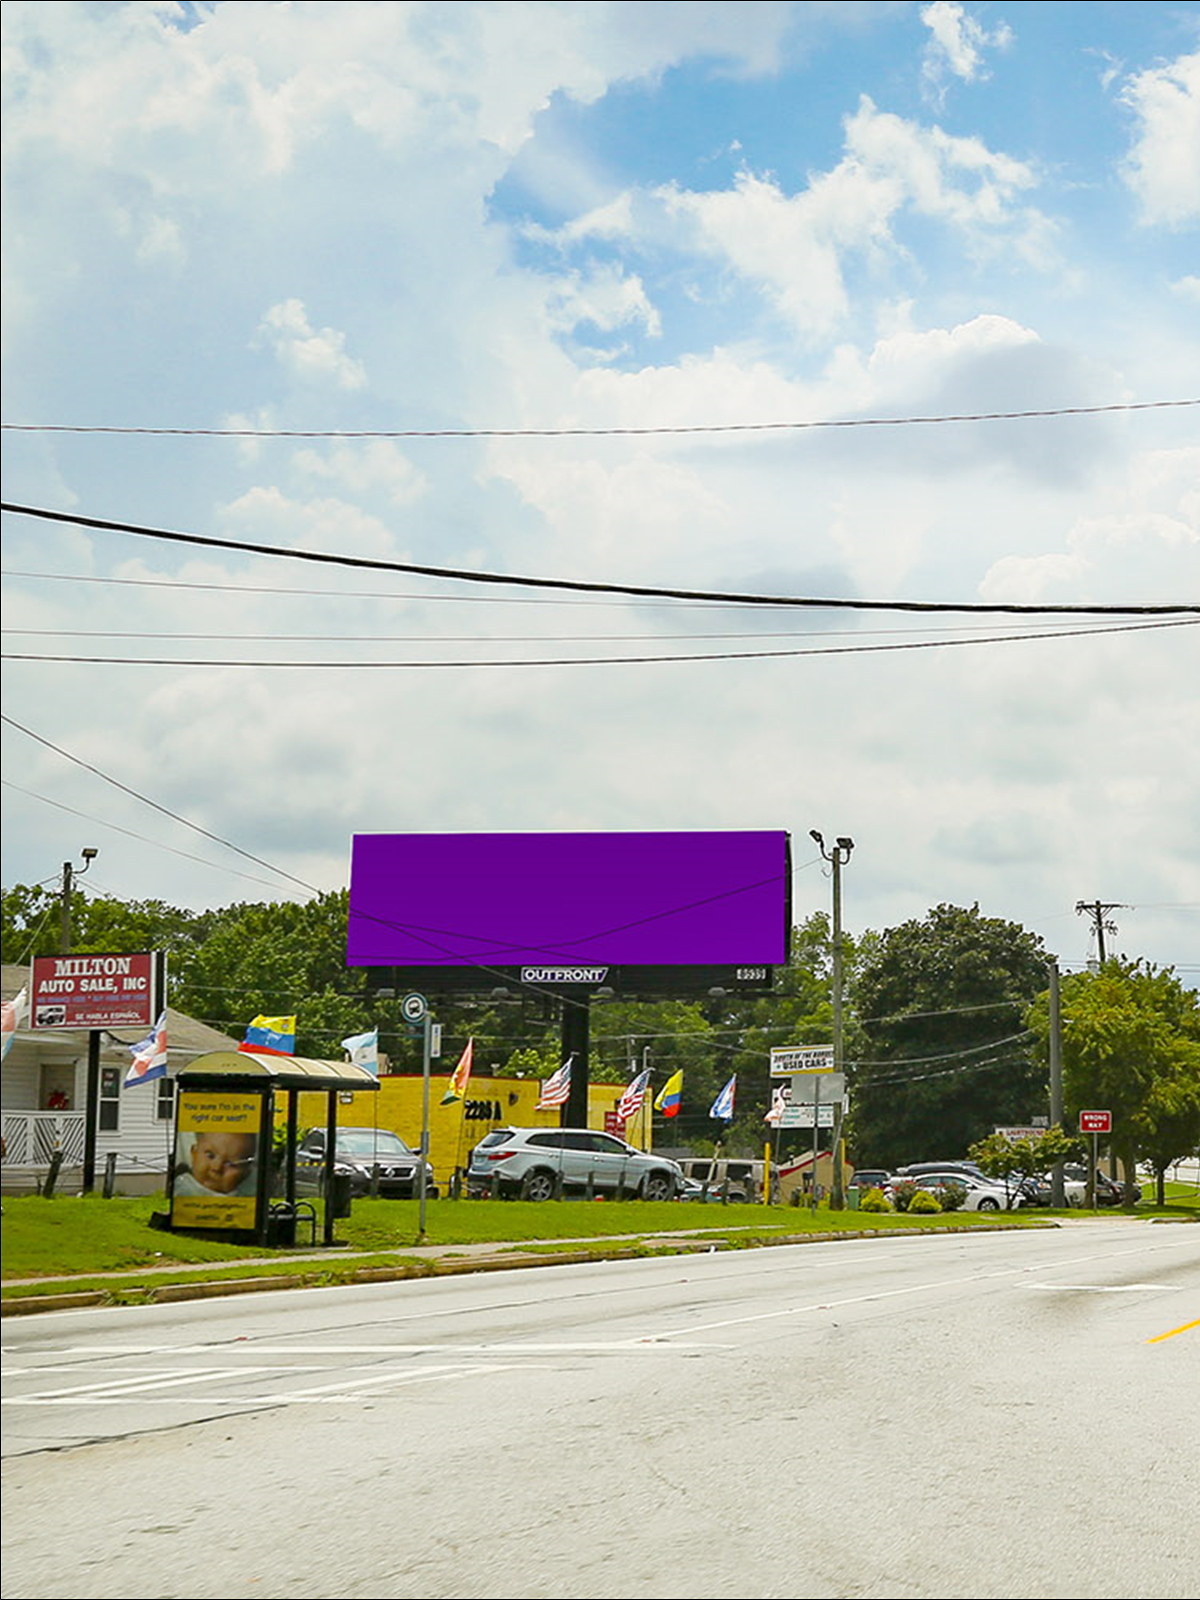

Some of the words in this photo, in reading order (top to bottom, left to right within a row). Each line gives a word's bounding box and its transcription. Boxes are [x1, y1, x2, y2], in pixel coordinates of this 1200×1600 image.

[54, 957, 132, 977] MILTON
[524, 969, 603, 981] OUTFRONT
[38, 979, 75, 993] AUTO
[80, 978, 118, 993] SALE,
[123, 977, 147, 990] INC
[783, 1060, 803, 1070] USED
[805, 1058, 827, 1068] CARS
[184, 1102, 198, 1111] You
